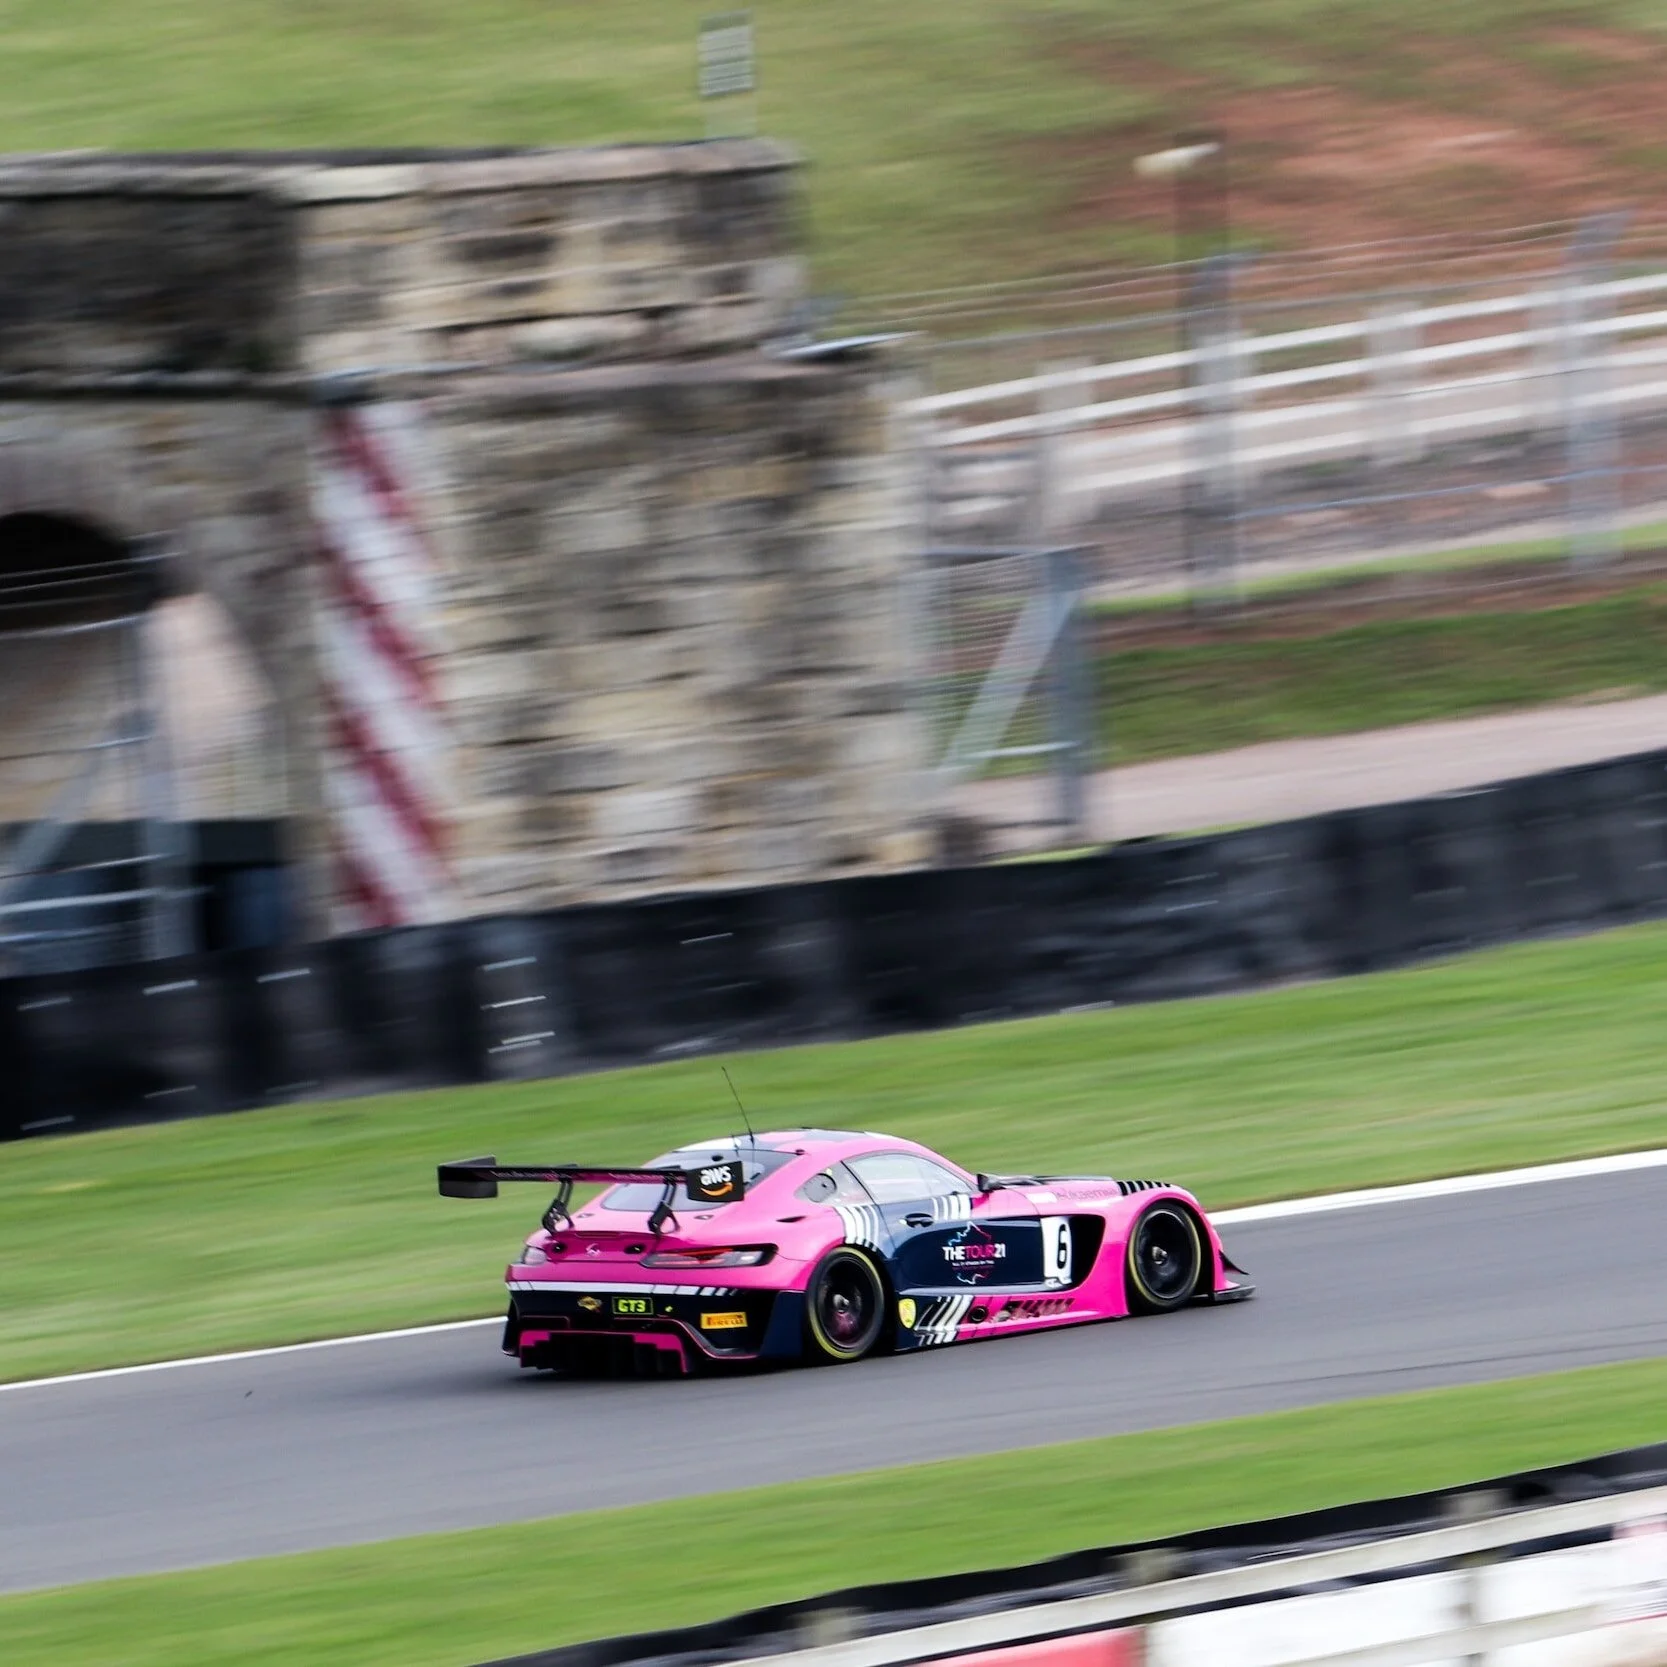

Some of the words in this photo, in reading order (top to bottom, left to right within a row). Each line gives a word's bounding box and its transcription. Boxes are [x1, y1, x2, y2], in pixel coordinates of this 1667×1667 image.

[700, 1166, 732, 1187] aws
[1057, 1223, 1068, 1269] 6
[616, 1299, 646, 1313] GT3
